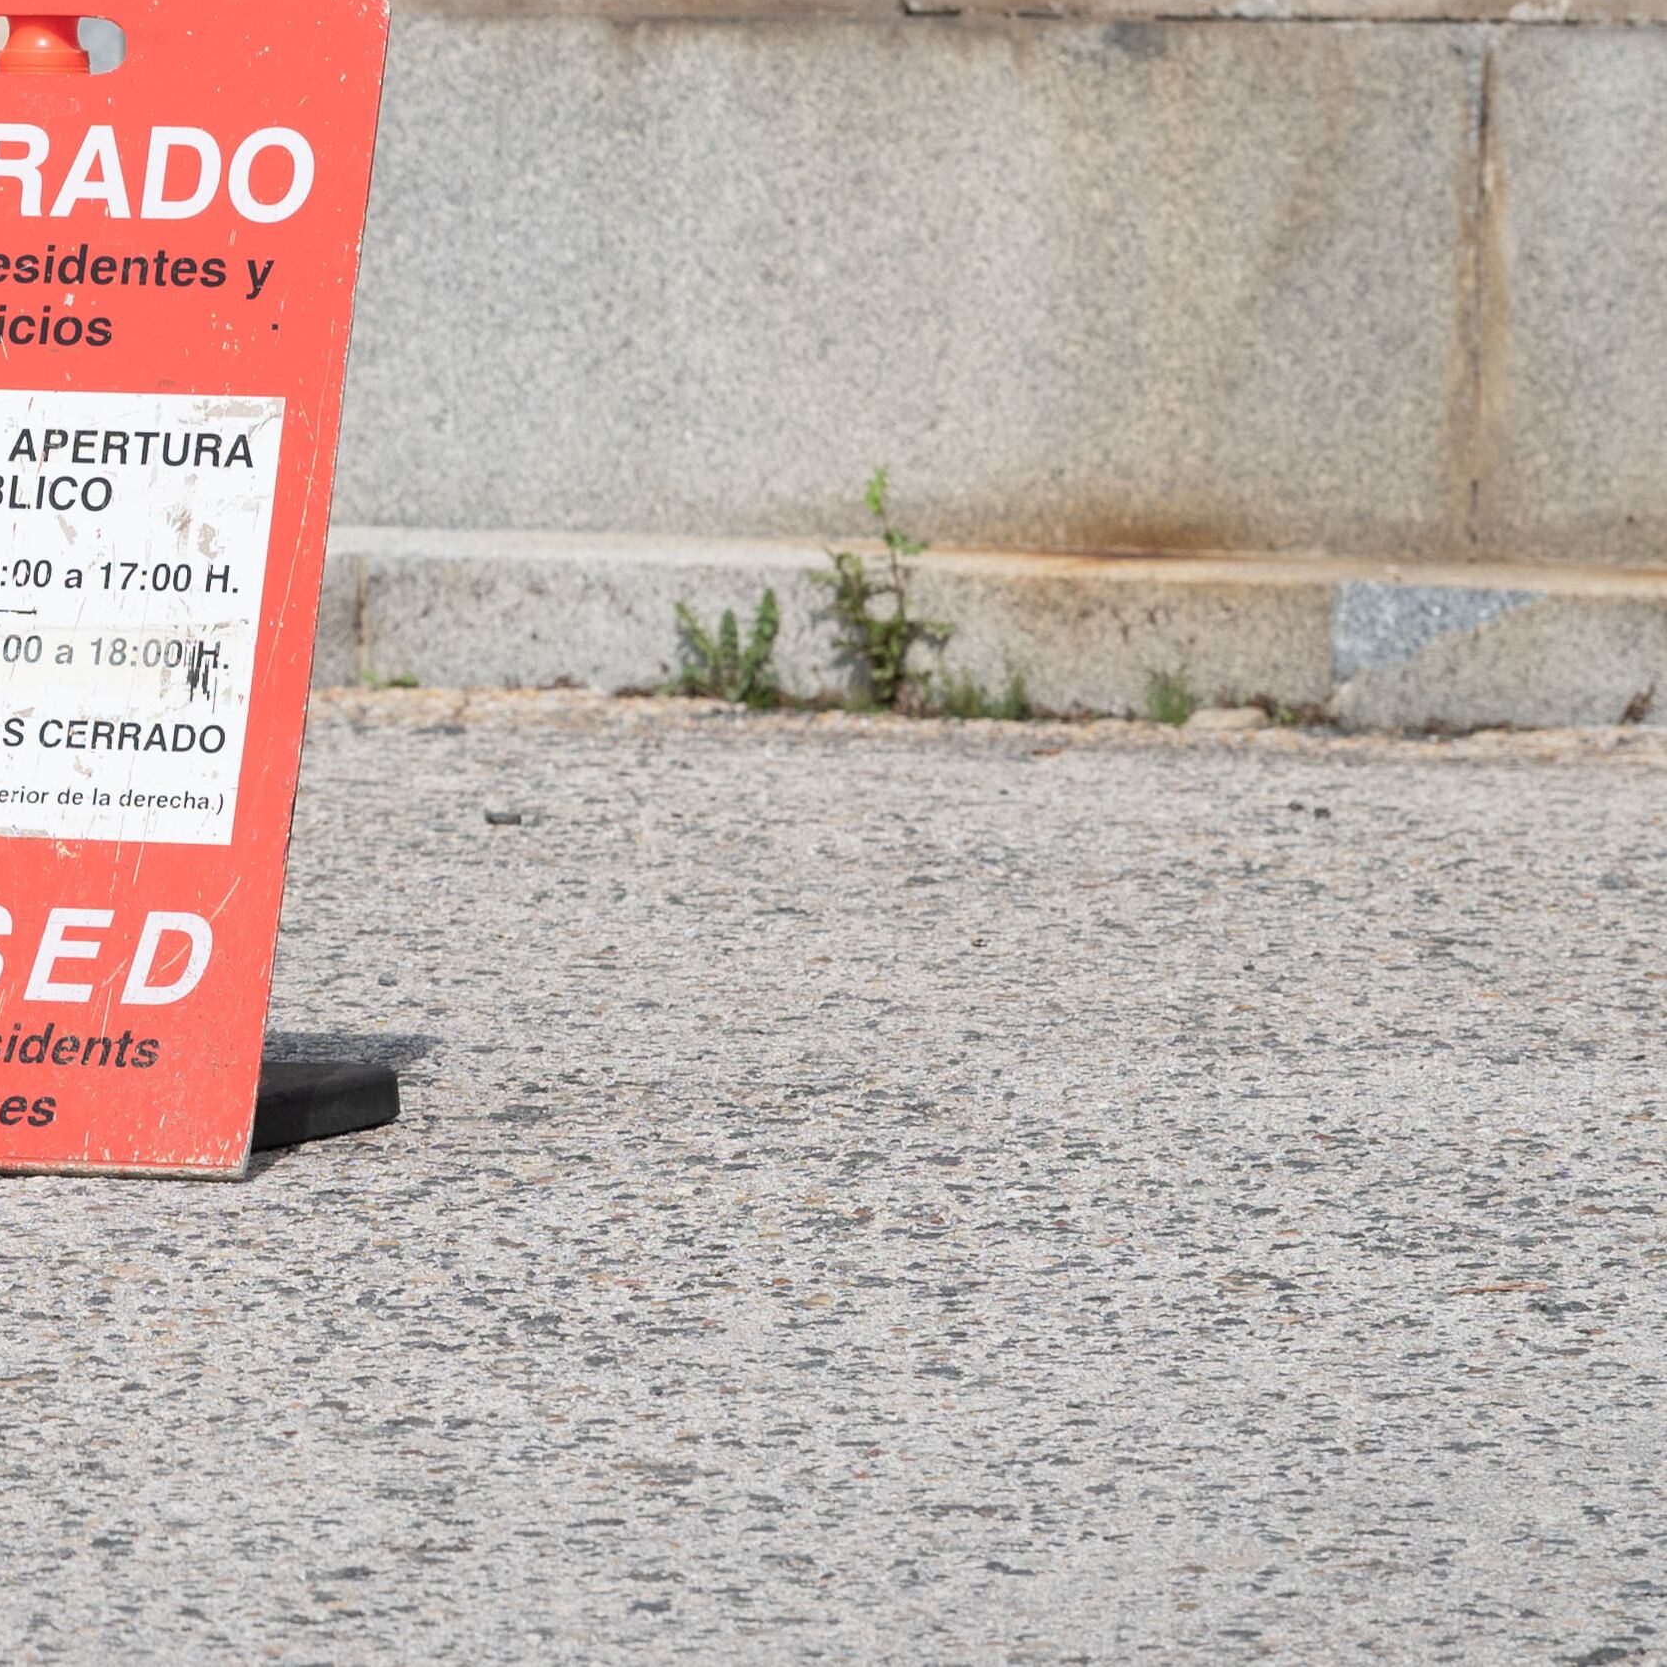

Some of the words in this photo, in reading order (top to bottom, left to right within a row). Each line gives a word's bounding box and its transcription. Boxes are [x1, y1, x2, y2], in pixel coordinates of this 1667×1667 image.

[247, 260, 274, 299] y
[9, 429, 254, 468] APERTURA
[64, 567, 83, 590] a
[100, 562, 192, 593] 17:00
[205, 566, 239, 594] H.
[55, 643, 73, 664] a
[91, 637, 183, 668] 18:00
[39, 720, 226, 753] CERRADO
[57, 788, 83, 805] de
[92, 788, 110, 806] la
[119, 789, 224, 814] derecha.)
